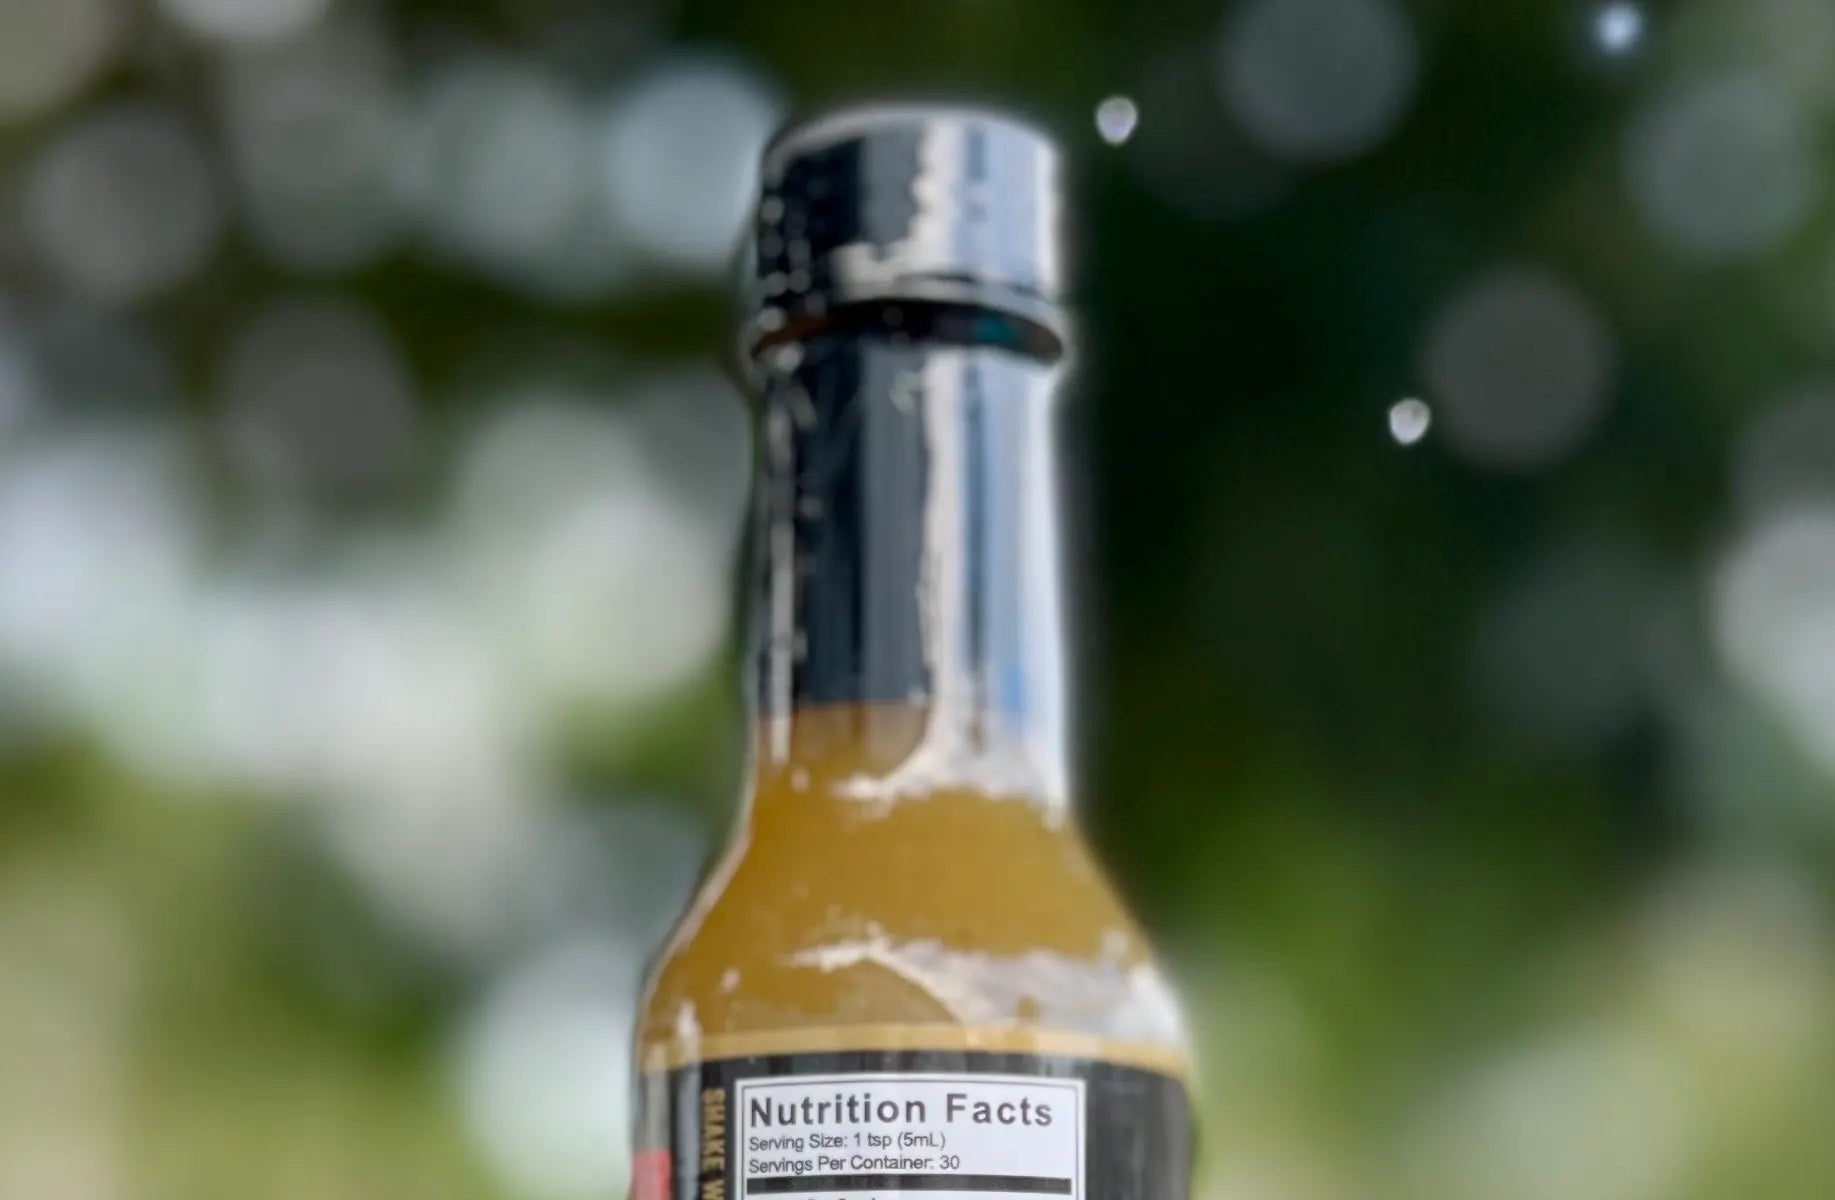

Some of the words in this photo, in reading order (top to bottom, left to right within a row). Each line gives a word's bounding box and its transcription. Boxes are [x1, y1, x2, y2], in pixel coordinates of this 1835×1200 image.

[750, 1093, 926, 1127] Nutrition
[947, 1093, 1053, 1126] Facts
[701, 1088, 726, 1172] SHAKE
[749, 1135, 804, 1152] Serving
[809, 1134, 848, 1149] Size:
[854, 1134, 861, 1147] 1
[867, 1134, 892, 1150] tsp
[897, 1133, 946, 1150] (5mL)
[749, 1158, 813, 1175] Servings
[818, 1157, 846, 1171] Per
[940, 1156, 960, 1170] 30
